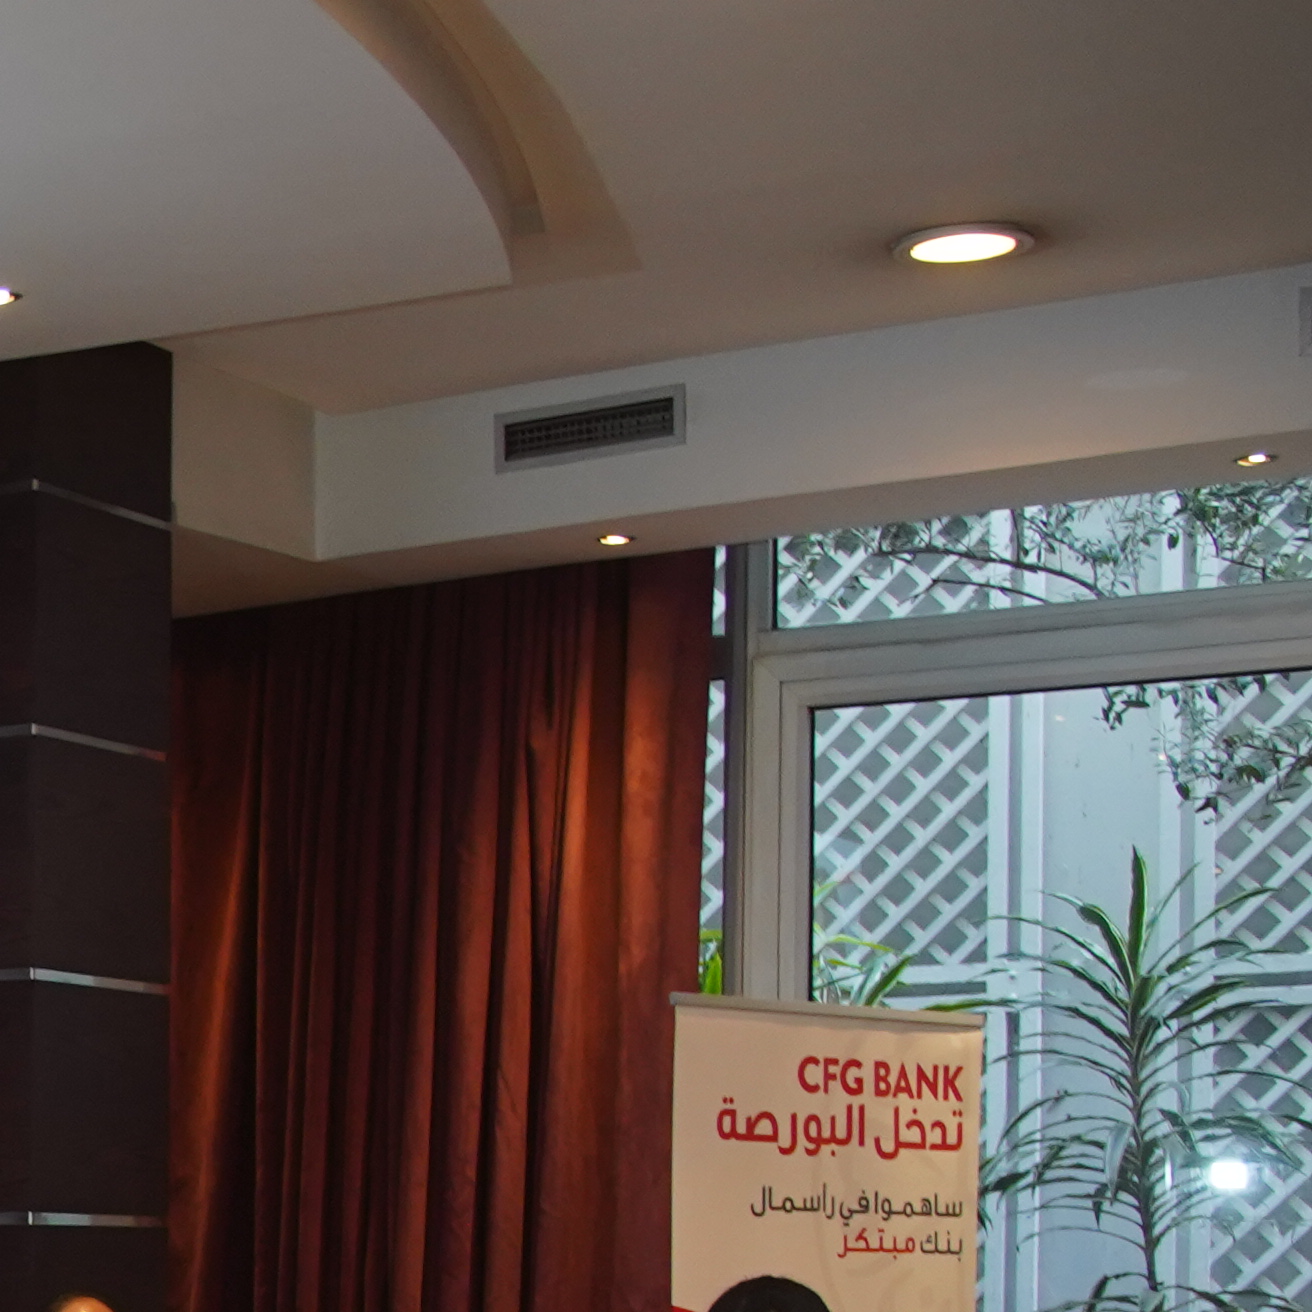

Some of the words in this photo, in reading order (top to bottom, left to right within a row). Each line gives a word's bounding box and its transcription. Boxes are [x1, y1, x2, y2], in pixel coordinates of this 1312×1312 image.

[798, 1056, 864, 1096] CFG
[874, 1061, 963, 1102] BANK
[717, 1097, 865, 1157] البورصة
[874, 1106, 963, 1160] تدخل
[839, 1189, 870, 1227] في
[875, 1190, 963, 1221] ساهموا
[837, 1228, 915, 1260] مبتكر
[920, 1230, 963, 1262] بنك
